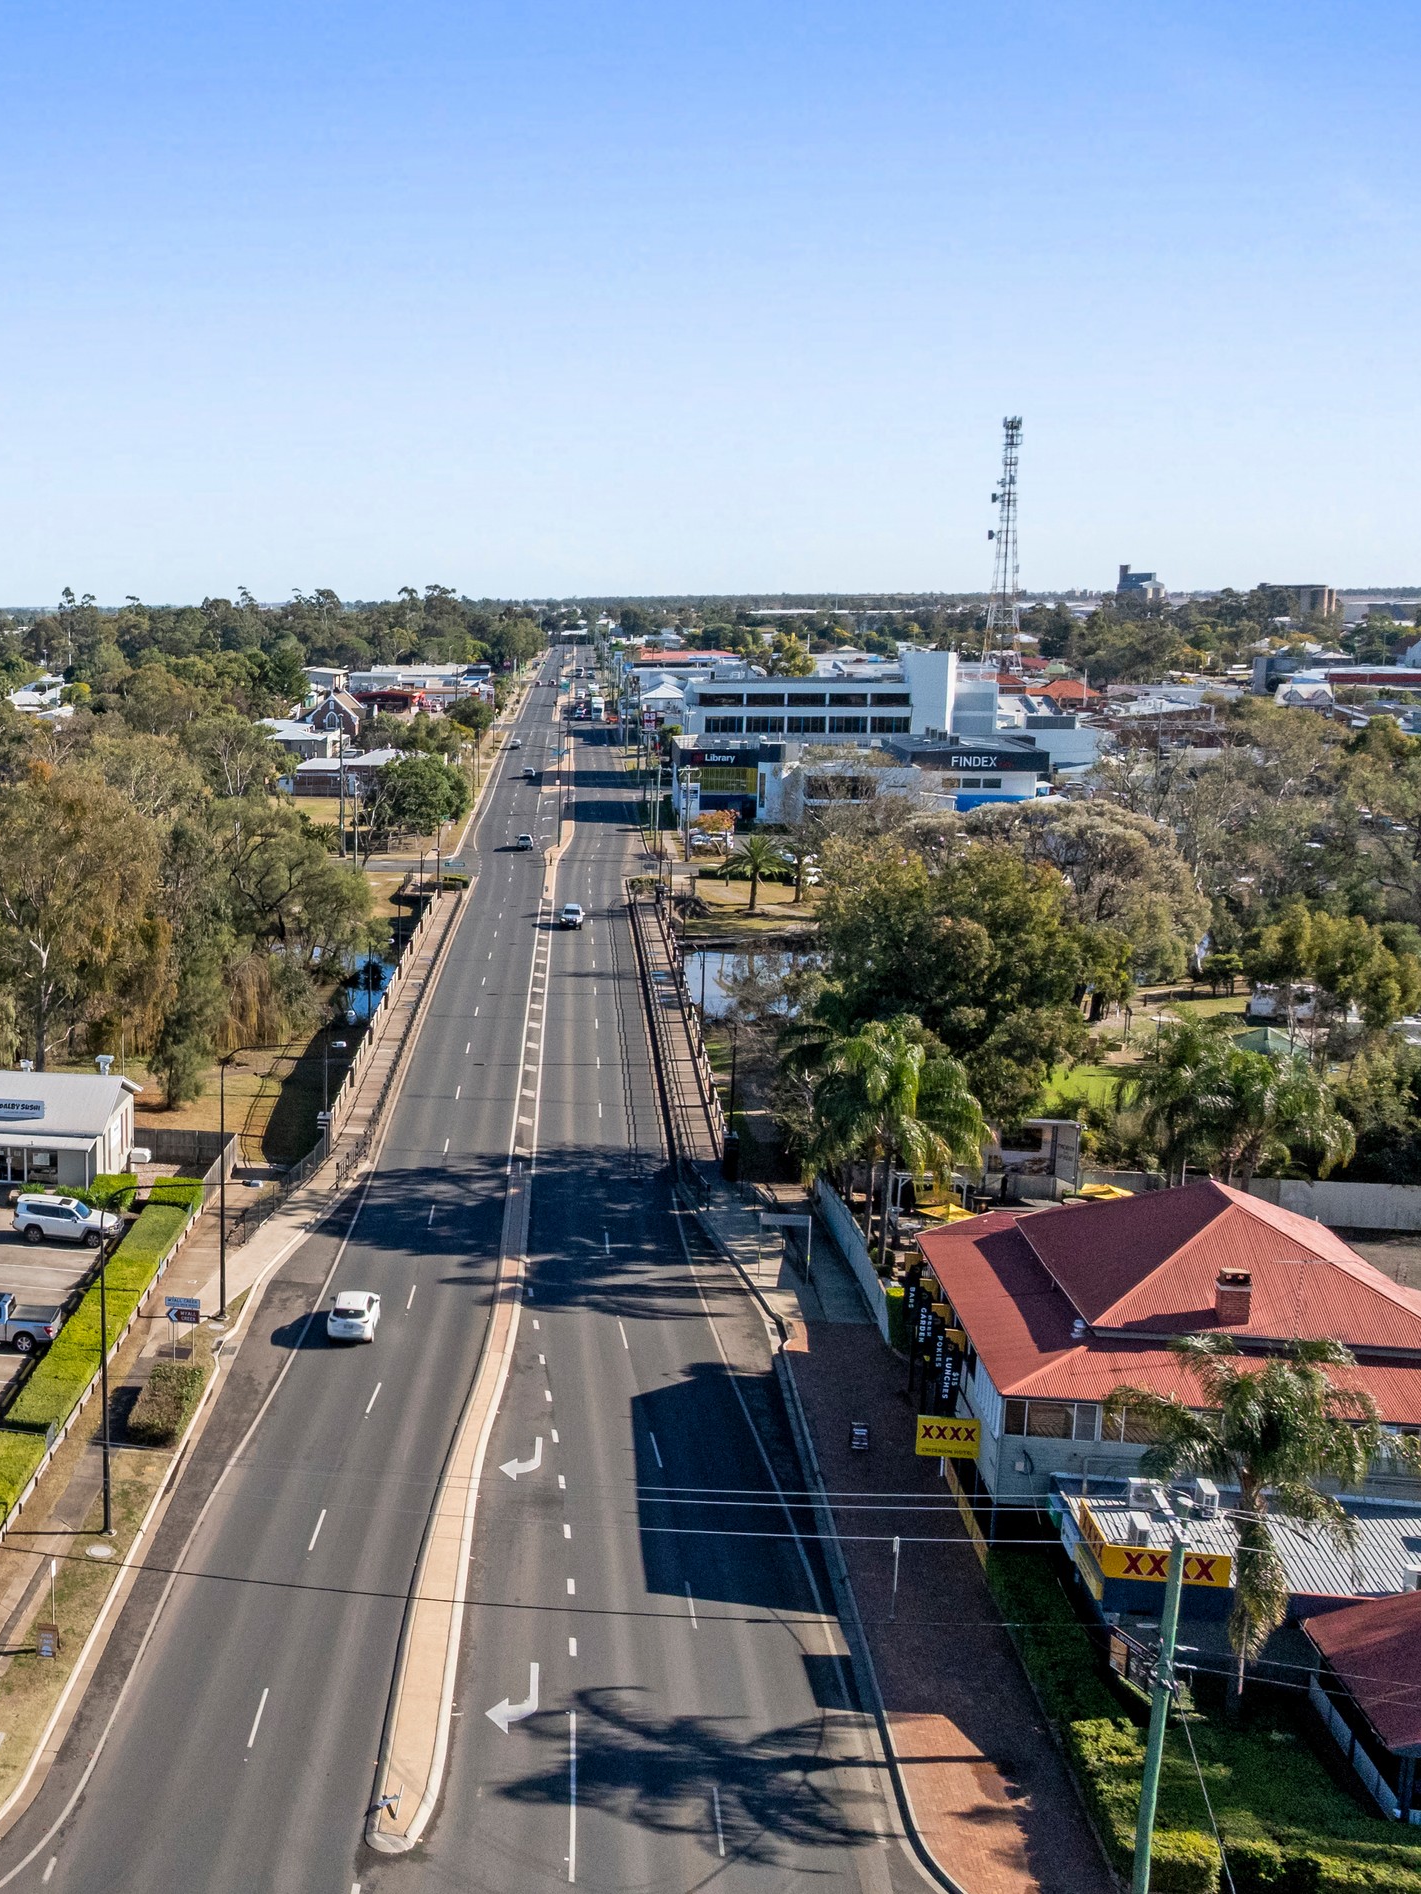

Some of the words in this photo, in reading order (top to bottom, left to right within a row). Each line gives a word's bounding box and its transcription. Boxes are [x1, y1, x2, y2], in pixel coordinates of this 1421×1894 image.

[705, 753, 735, 763] Library
[951, 756, 998, 767] FINDEX
[20, 1103, 41, 1111] SUSHI
[908, 1286, 916, 1309] BARS
[918, 1307, 927, 1343] GARDEN
[935, 1335, 944, 1368] POKIES
[941, 1357, 953, 1399] LUNCHES
[951, 1372, 960, 1386] $15
[921, 1424, 976, 1442] XXXX
